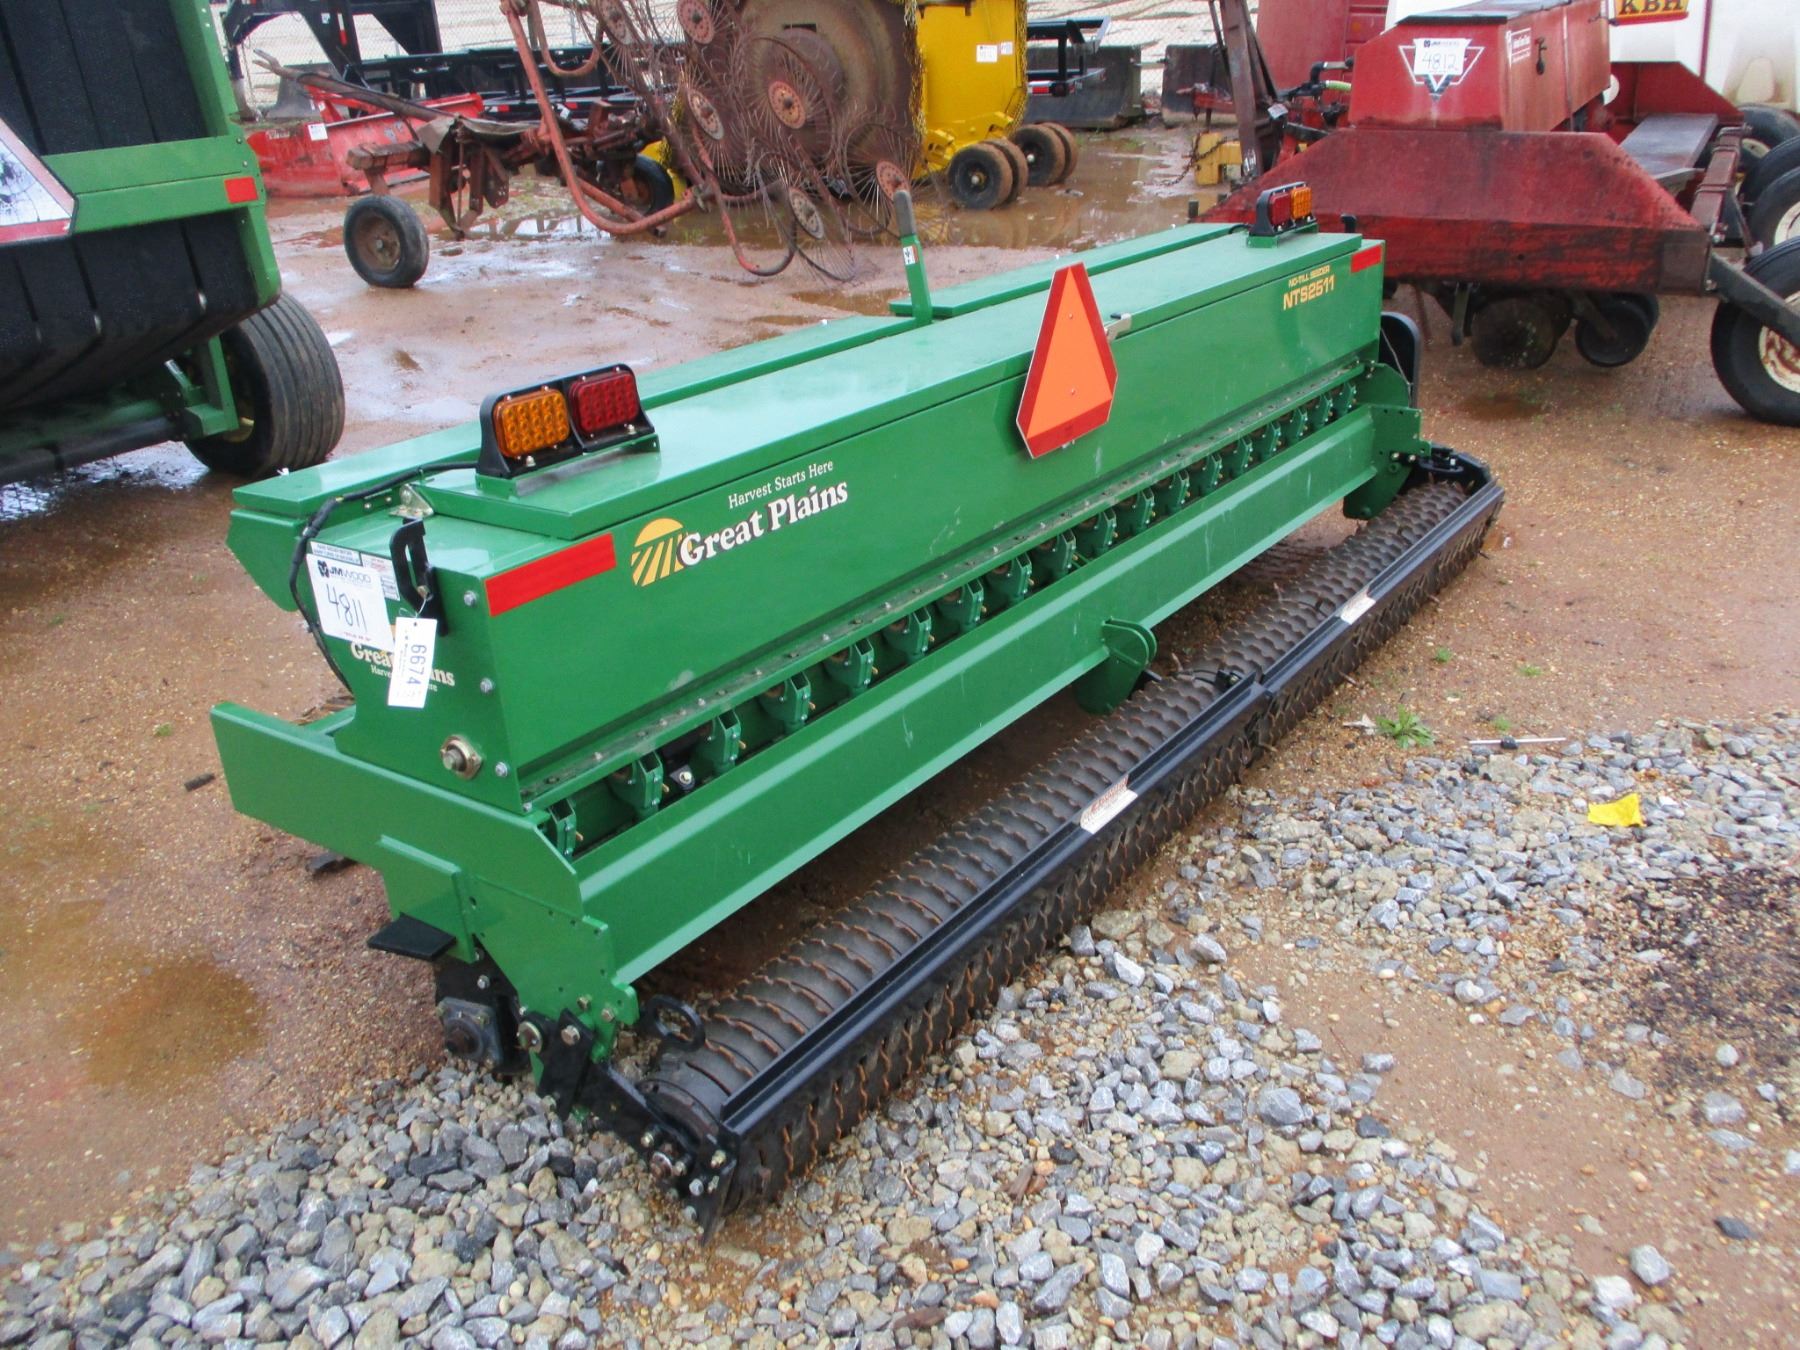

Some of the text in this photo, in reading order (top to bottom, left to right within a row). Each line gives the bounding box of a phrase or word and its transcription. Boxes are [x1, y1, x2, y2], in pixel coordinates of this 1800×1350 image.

[1283, 274, 1335, 310] NTS2511
[728, 460, 834, 509] Harvest Starts Here
[679, 481, 848, 566] Great Plains
[325, 583, 368, 633] 4811
[351, 640, 392, 667] Grea
[406, 644, 427, 685] 6674
